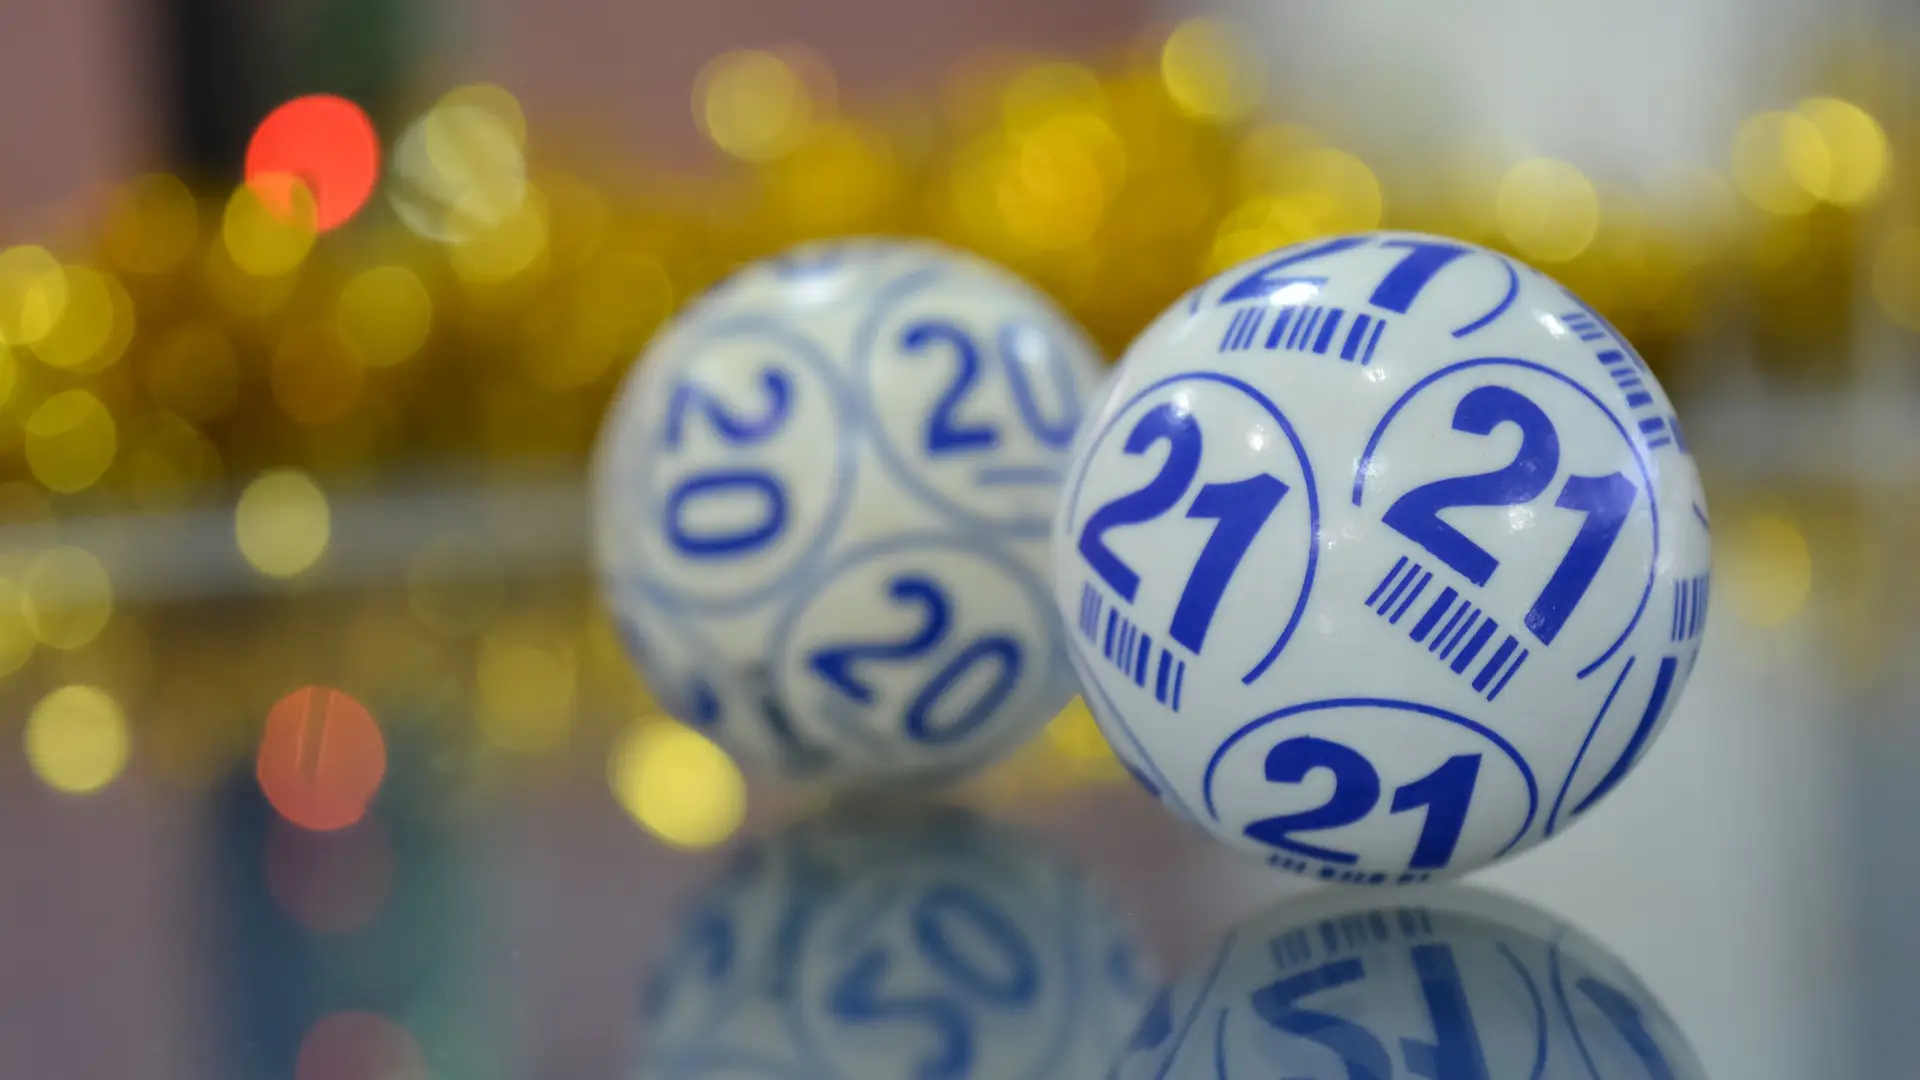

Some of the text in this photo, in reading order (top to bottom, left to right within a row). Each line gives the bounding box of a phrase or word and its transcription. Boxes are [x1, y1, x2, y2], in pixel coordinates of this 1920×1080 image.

[664, 366, 793, 558] 20
[902, 320, 1083, 456] 20
[1077, 402, 1290, 656] 21
[1382, 385, 1638, 645] 21
[809, 573, 1024, 744] 20
[1243, 735, 1483, 870] 21
